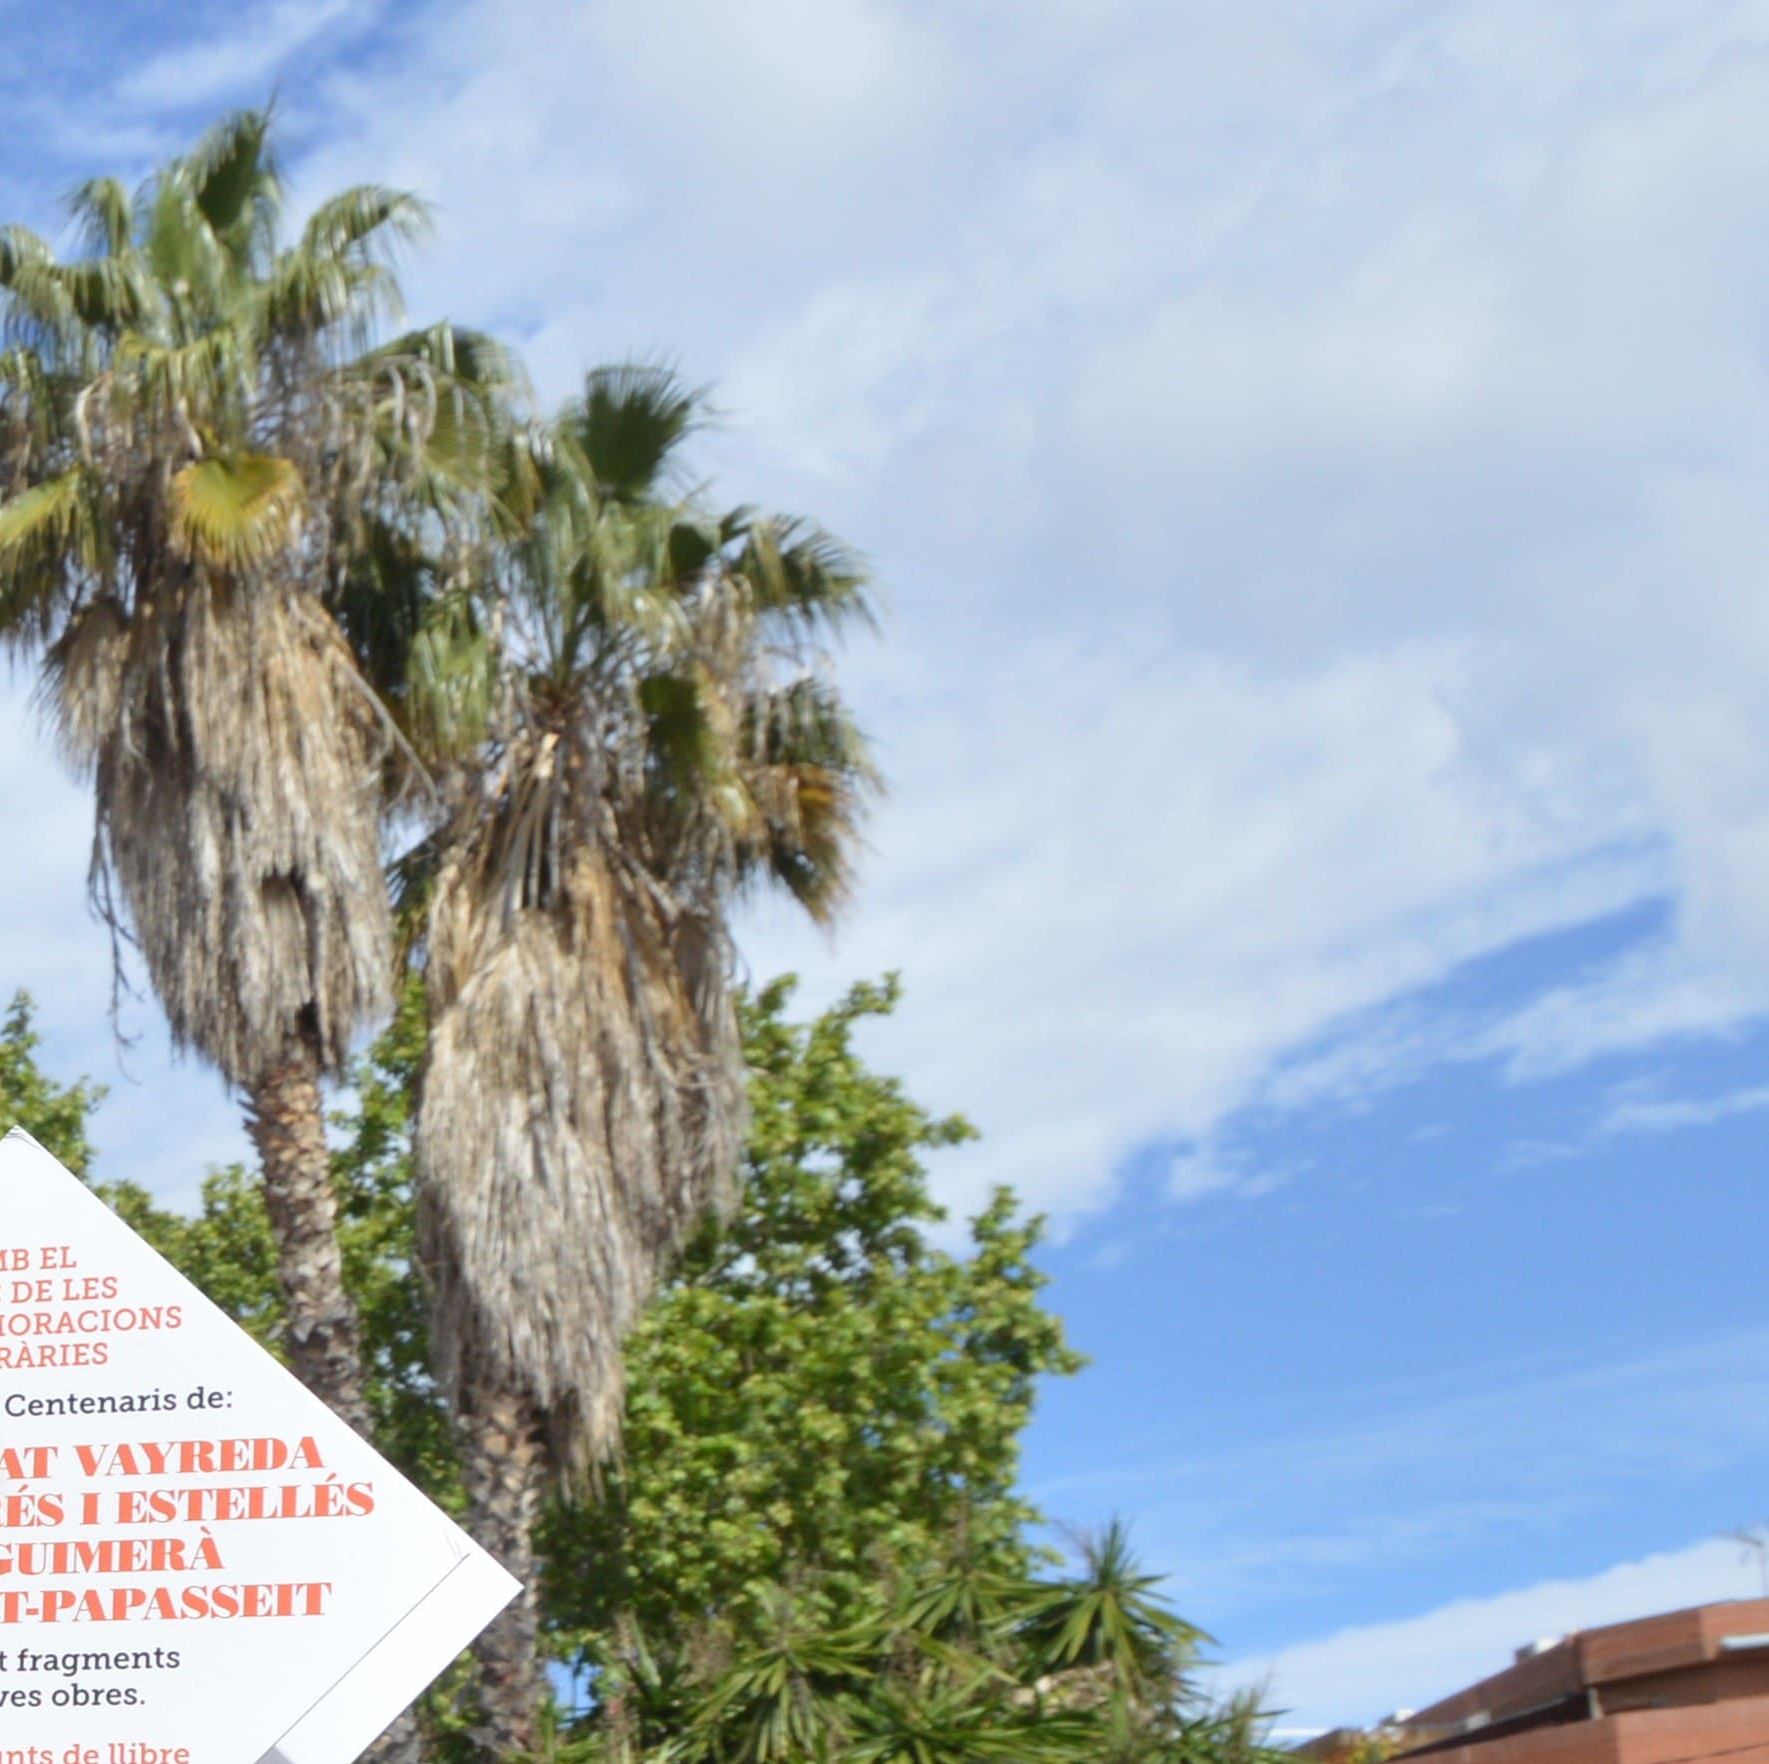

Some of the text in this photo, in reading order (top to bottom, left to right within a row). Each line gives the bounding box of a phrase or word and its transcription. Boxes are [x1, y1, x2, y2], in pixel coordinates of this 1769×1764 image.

[41, 1247, 76, 1269] EL
[11, 1280, 52, 1303] DE
[63, 1277, 117, 1300] LES
[5, 1388, 176, 1417] Centenaris
[187, 1386, 232, 1409] de:
[75, 1437, 323, 1476] VAYREDA
[82, 1493, 99, 1525] I
[117, 1473, 375, 1523] ESTELLÉS
[17, 1648, 180, 1677] fragments
[52, 1683, 145, 1706] obres.
